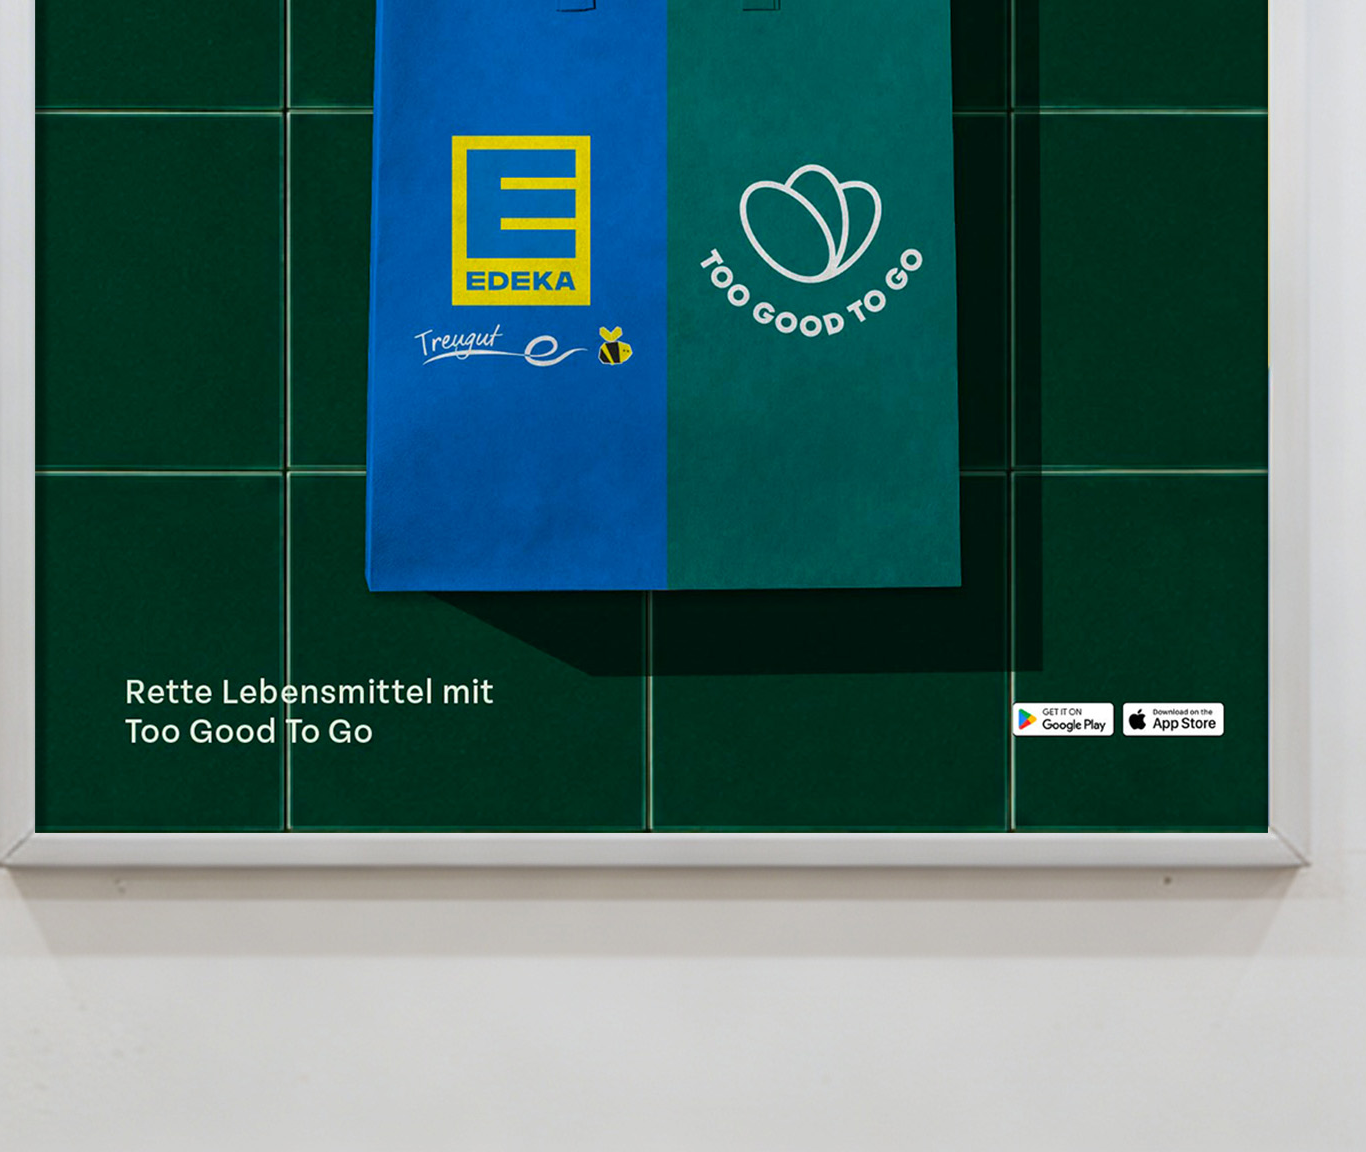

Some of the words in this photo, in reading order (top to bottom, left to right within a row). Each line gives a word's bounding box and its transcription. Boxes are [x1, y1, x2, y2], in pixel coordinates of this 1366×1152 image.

[466, 271, 576, 291] EDEKA
[700, 248, 750, 307] TOO
[752, 301, 844, 337] GOOD
[846, 289, 886, 322] TO
[885, 248, 923, 290] GO
[126, 679, 212, 704] Rette
[223, 677, 432, 704] Lebensmittel
[443, 678, 494, 704] mit
[1042, 707, 1059, 716] GET
[1060, 708, 1067, 716] IT
[1068, 707, 1082, 716] ON
[1152, 708, 1189, 716] Download
[1200, 708, 1213, 716] the
[125, 718, 180, 744] Too
[190, 717, 275, 744] Good
[284, 718, 320, 744] To
[328, 718, 373, 744] Go
[1042, 718, 1082, 733] Google
[1083, 718, 1106, 733] Play
[1152, 717, 1179, 732] App
[1181, 717, 1217, 729] Store
